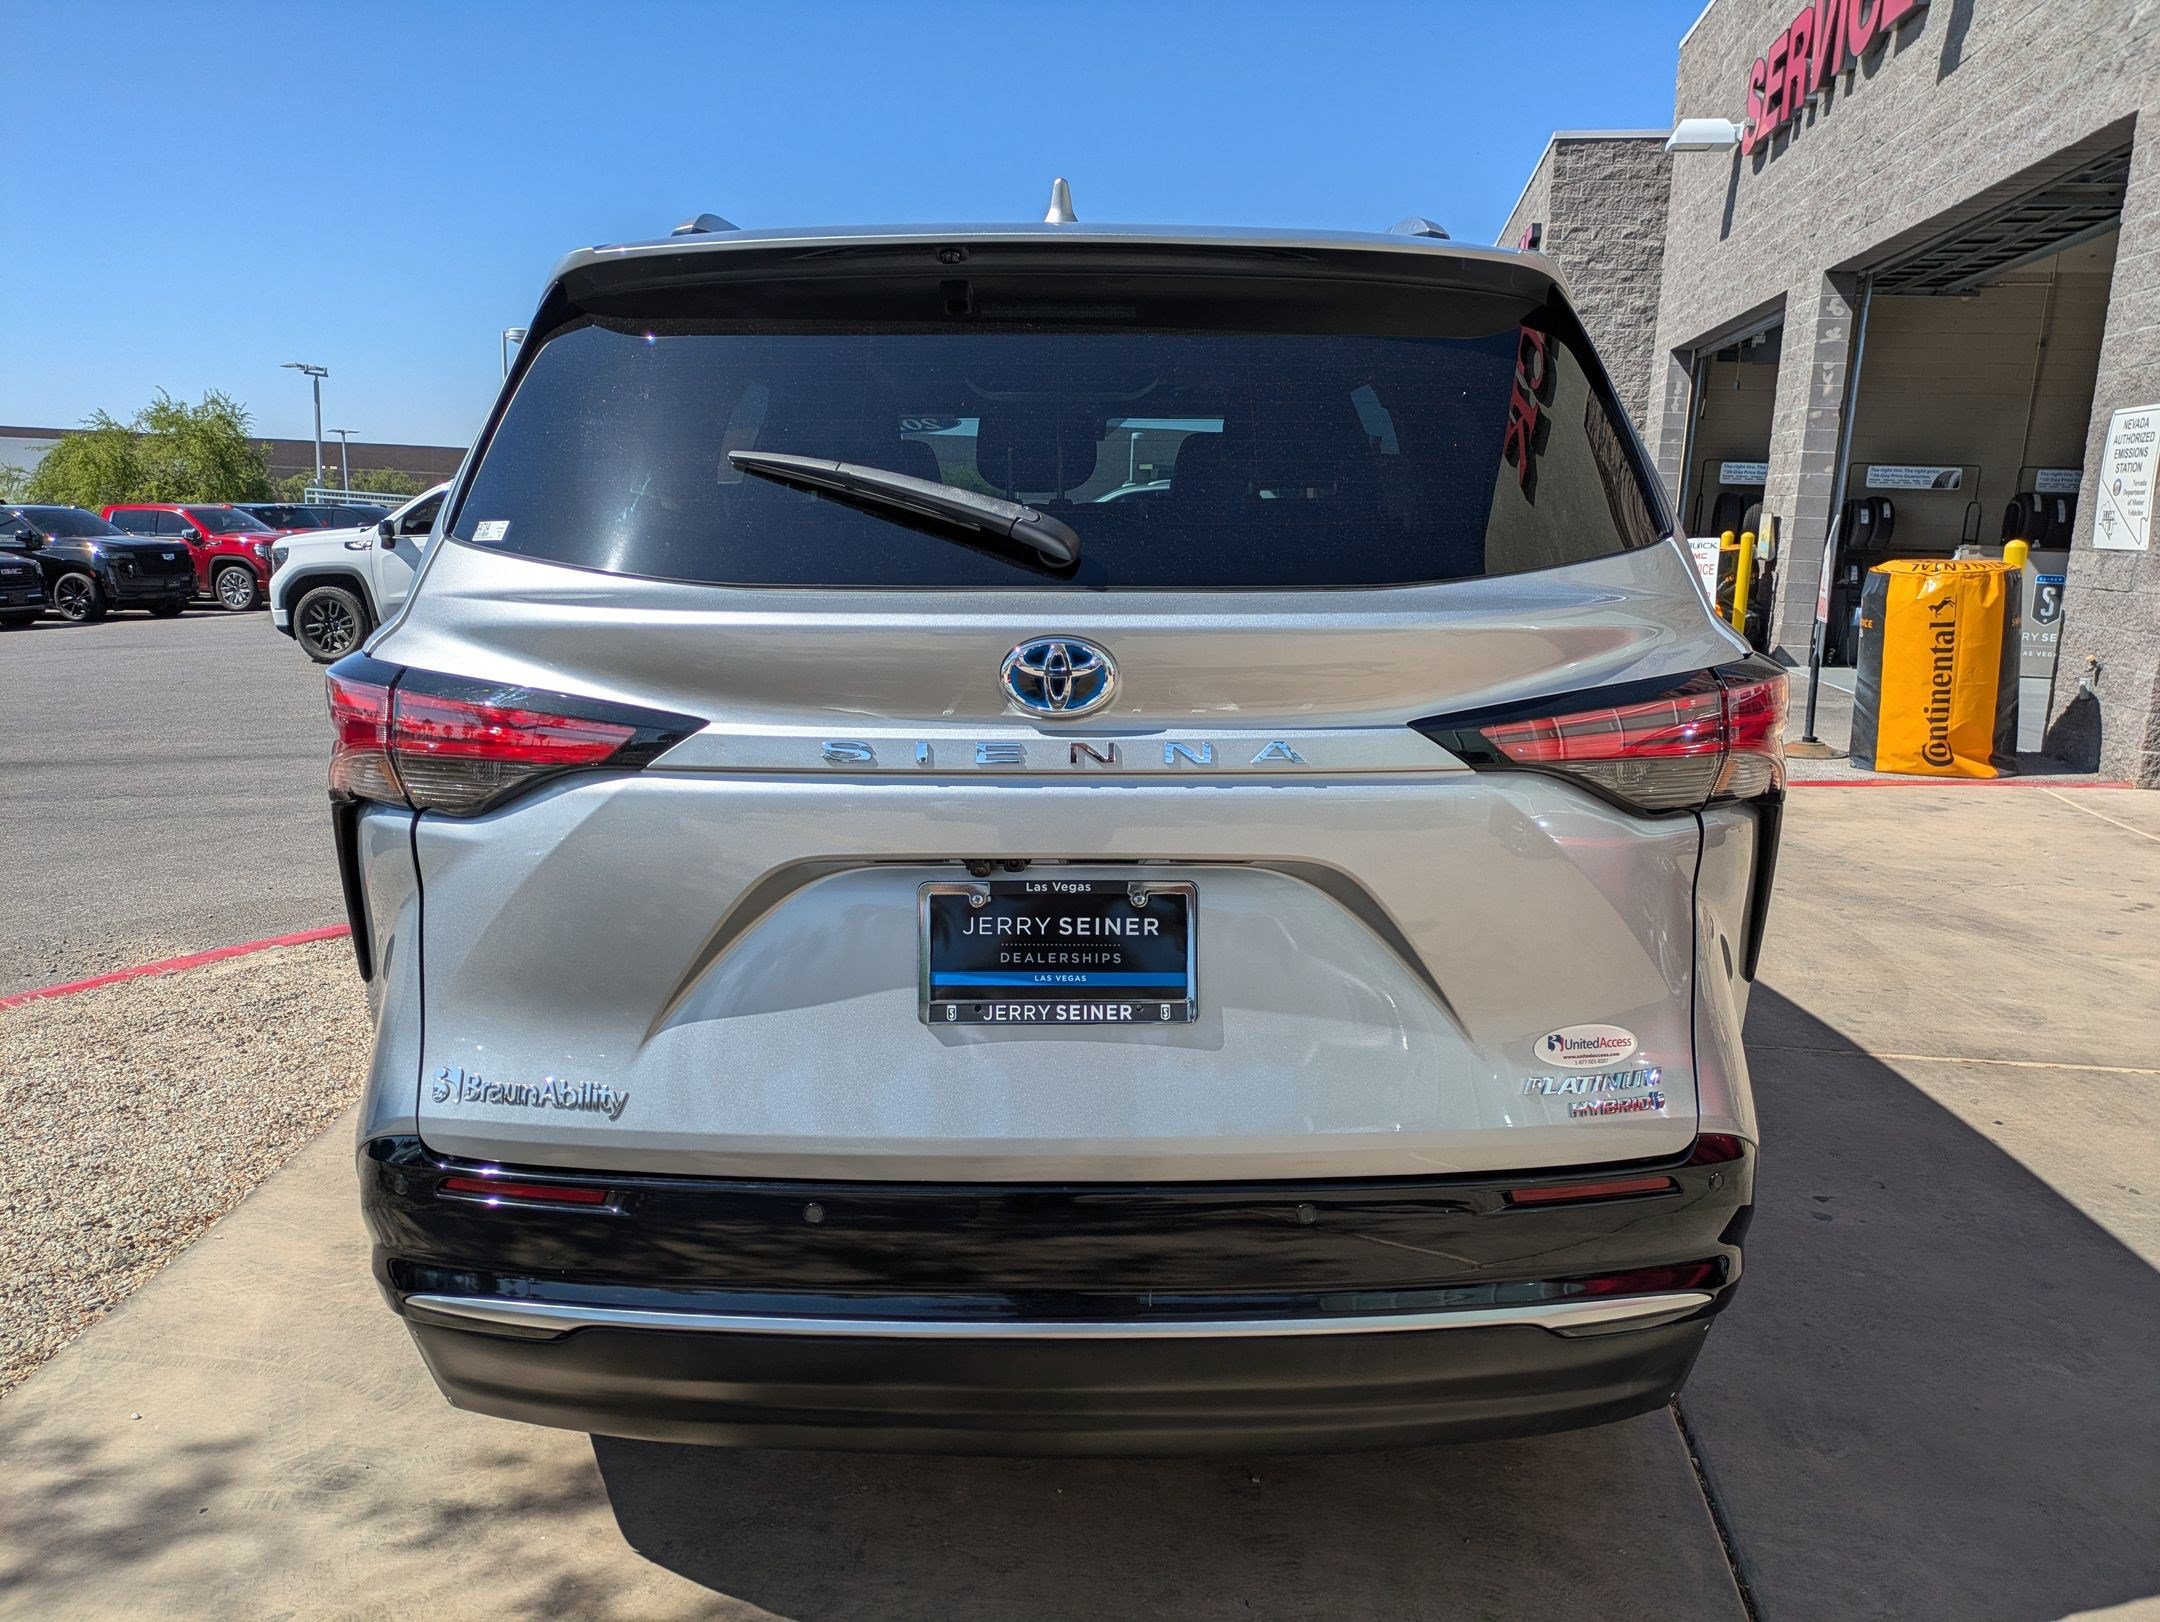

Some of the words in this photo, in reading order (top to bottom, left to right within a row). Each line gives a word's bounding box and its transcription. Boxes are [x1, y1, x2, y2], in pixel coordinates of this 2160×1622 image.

[1742, 0, 1914, 156] SERVI
[2123, 417, 2150, 430] NEVADA
[2113, 432, 2156, 445] AUTHORIZED
[2114, 447, 2149, 459] EMISSIONS
[2115, 462, 2143, 473] STATION
[1694, 552, 1708, 560] MC
[2040, 586, 2056, 617] S
[1922, 619, 1956, 768] Continental
[821, 741, 1308, 764] SIENNA
[1026, 882, 1048, 892] Las
[1052, 882, 1092, 893] Vegas
[963, 917, 1051, 935] JERRY
[1059, 917, 1160, 936] SEINER
[1000, 952, 1122, 964] DEALERSHIPS
[983, 1005, 1050, 1020] JERRY
[1056, 1005, 1132, 1020] SEINER
[1565, 1036, 1632, 1050] UnitedAccess
[1522, 1067, 1662, 1096] PLATINUM
[464, 1073, 630, 1121] BraunAbility
[1568, 1096, 1652, 1118] HYBRID
